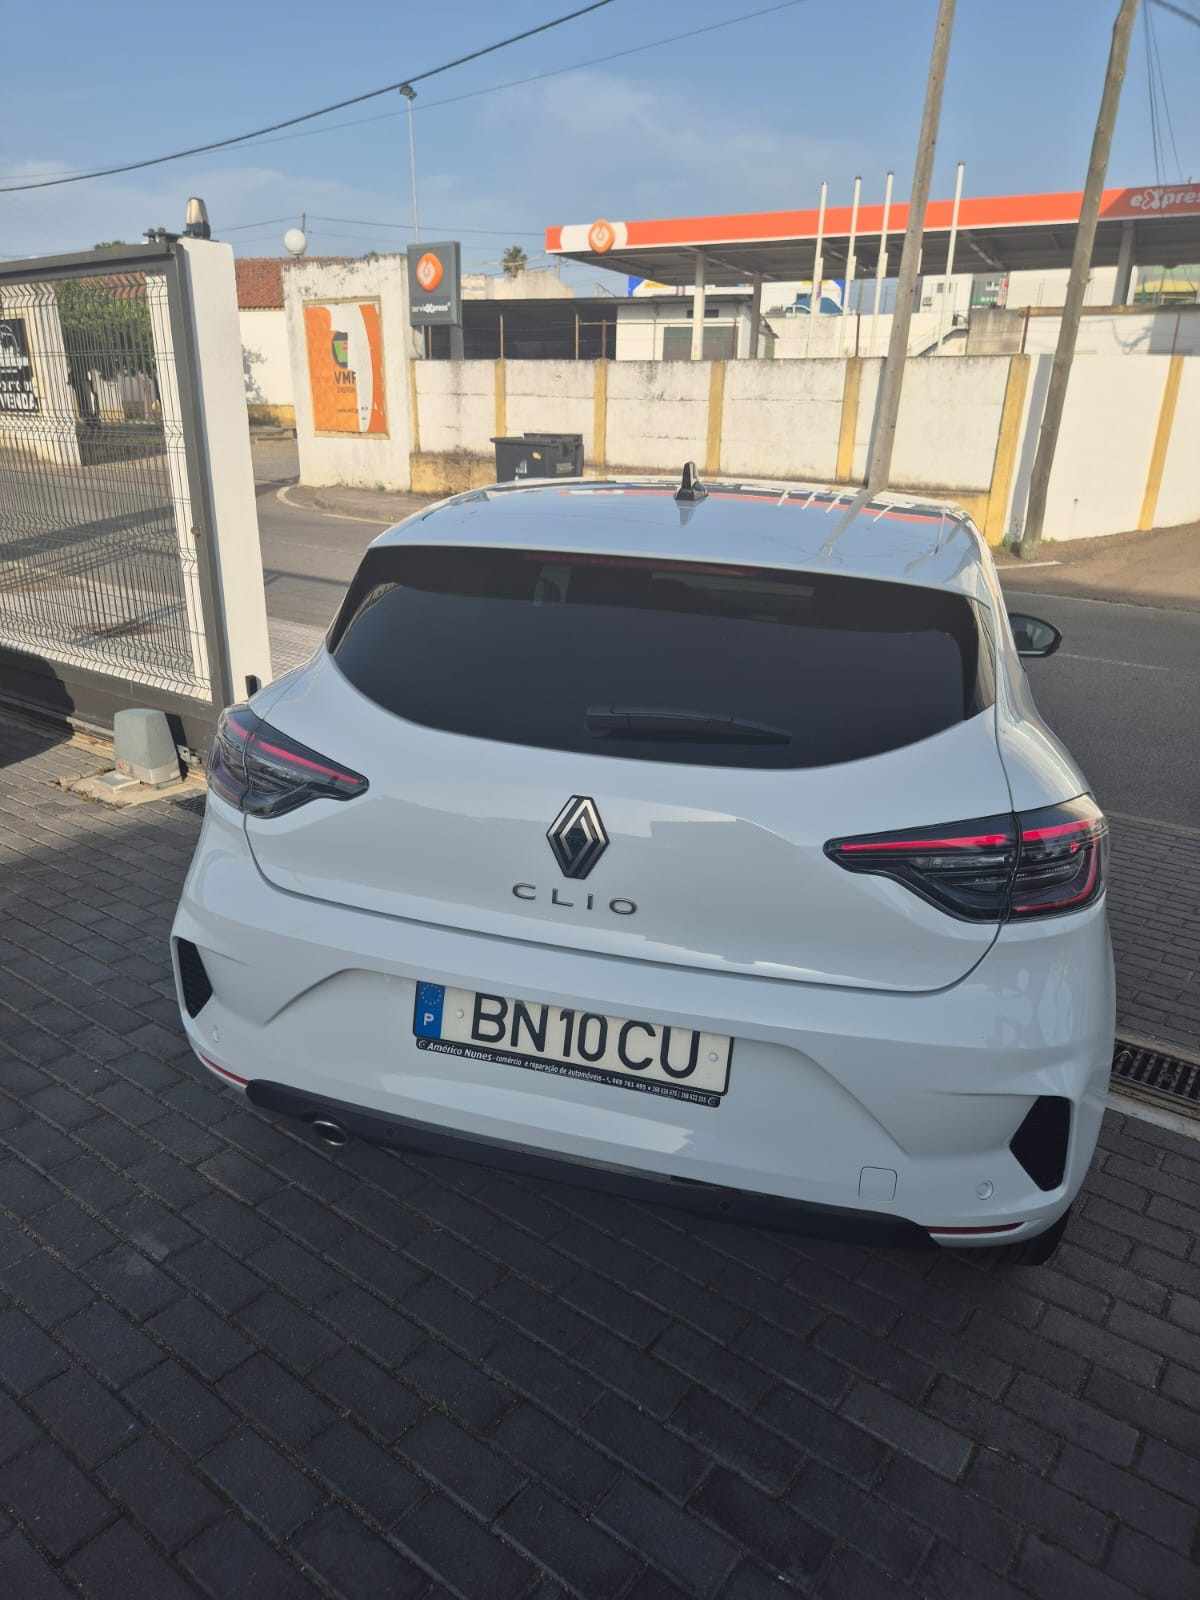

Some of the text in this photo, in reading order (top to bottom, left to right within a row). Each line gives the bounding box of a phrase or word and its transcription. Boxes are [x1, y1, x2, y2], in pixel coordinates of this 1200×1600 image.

[512, 883, 638, 916] CLIO
[423, 1012, 435, 1026] P
[427, 1042, 463, 1056] Américo
[464, 1048, 493, 1062] Nunes
[496, 1055, 522, 1066] comércio
[530, 1062, 559, 1073] reparação
